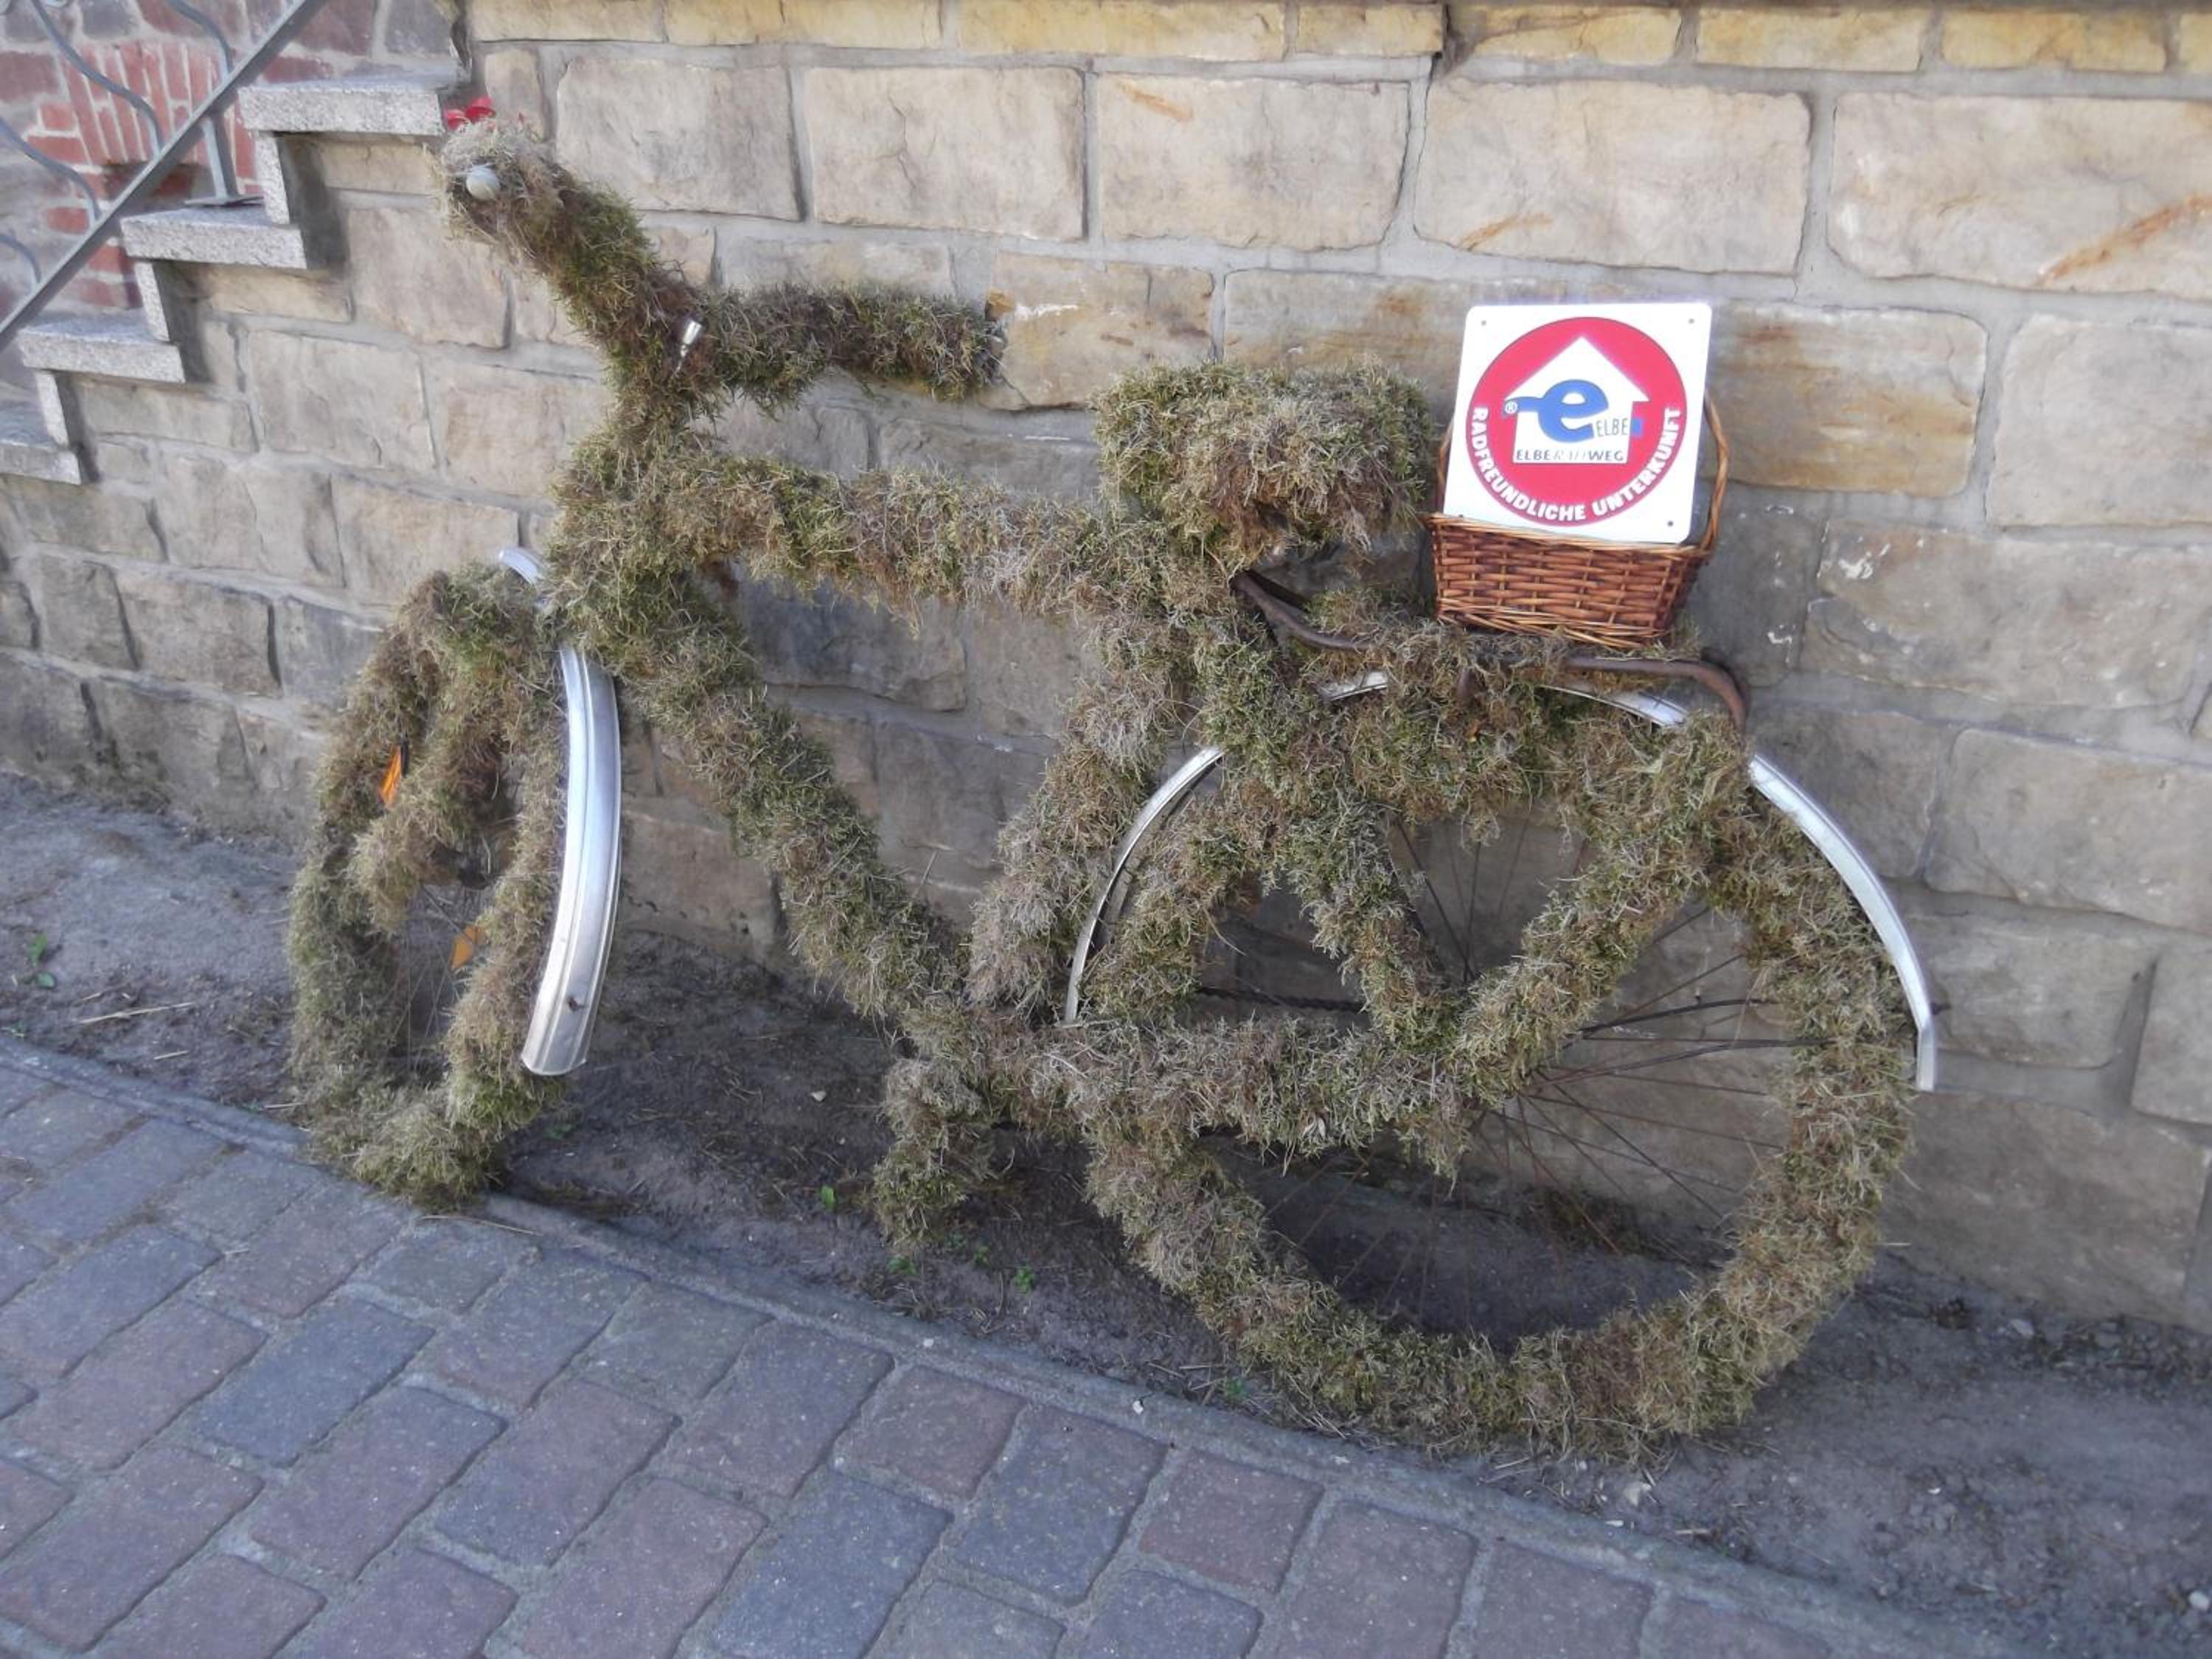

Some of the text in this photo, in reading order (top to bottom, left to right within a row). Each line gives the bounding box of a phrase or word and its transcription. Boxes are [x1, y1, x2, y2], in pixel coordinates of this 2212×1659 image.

[1596, 417, 1629, 437] ELBE
[1472, 407, 1681, 521] RADFREUNDLICHE UNTERKUNFT
[1515, 449, 1624, 462] ELBEWEG
